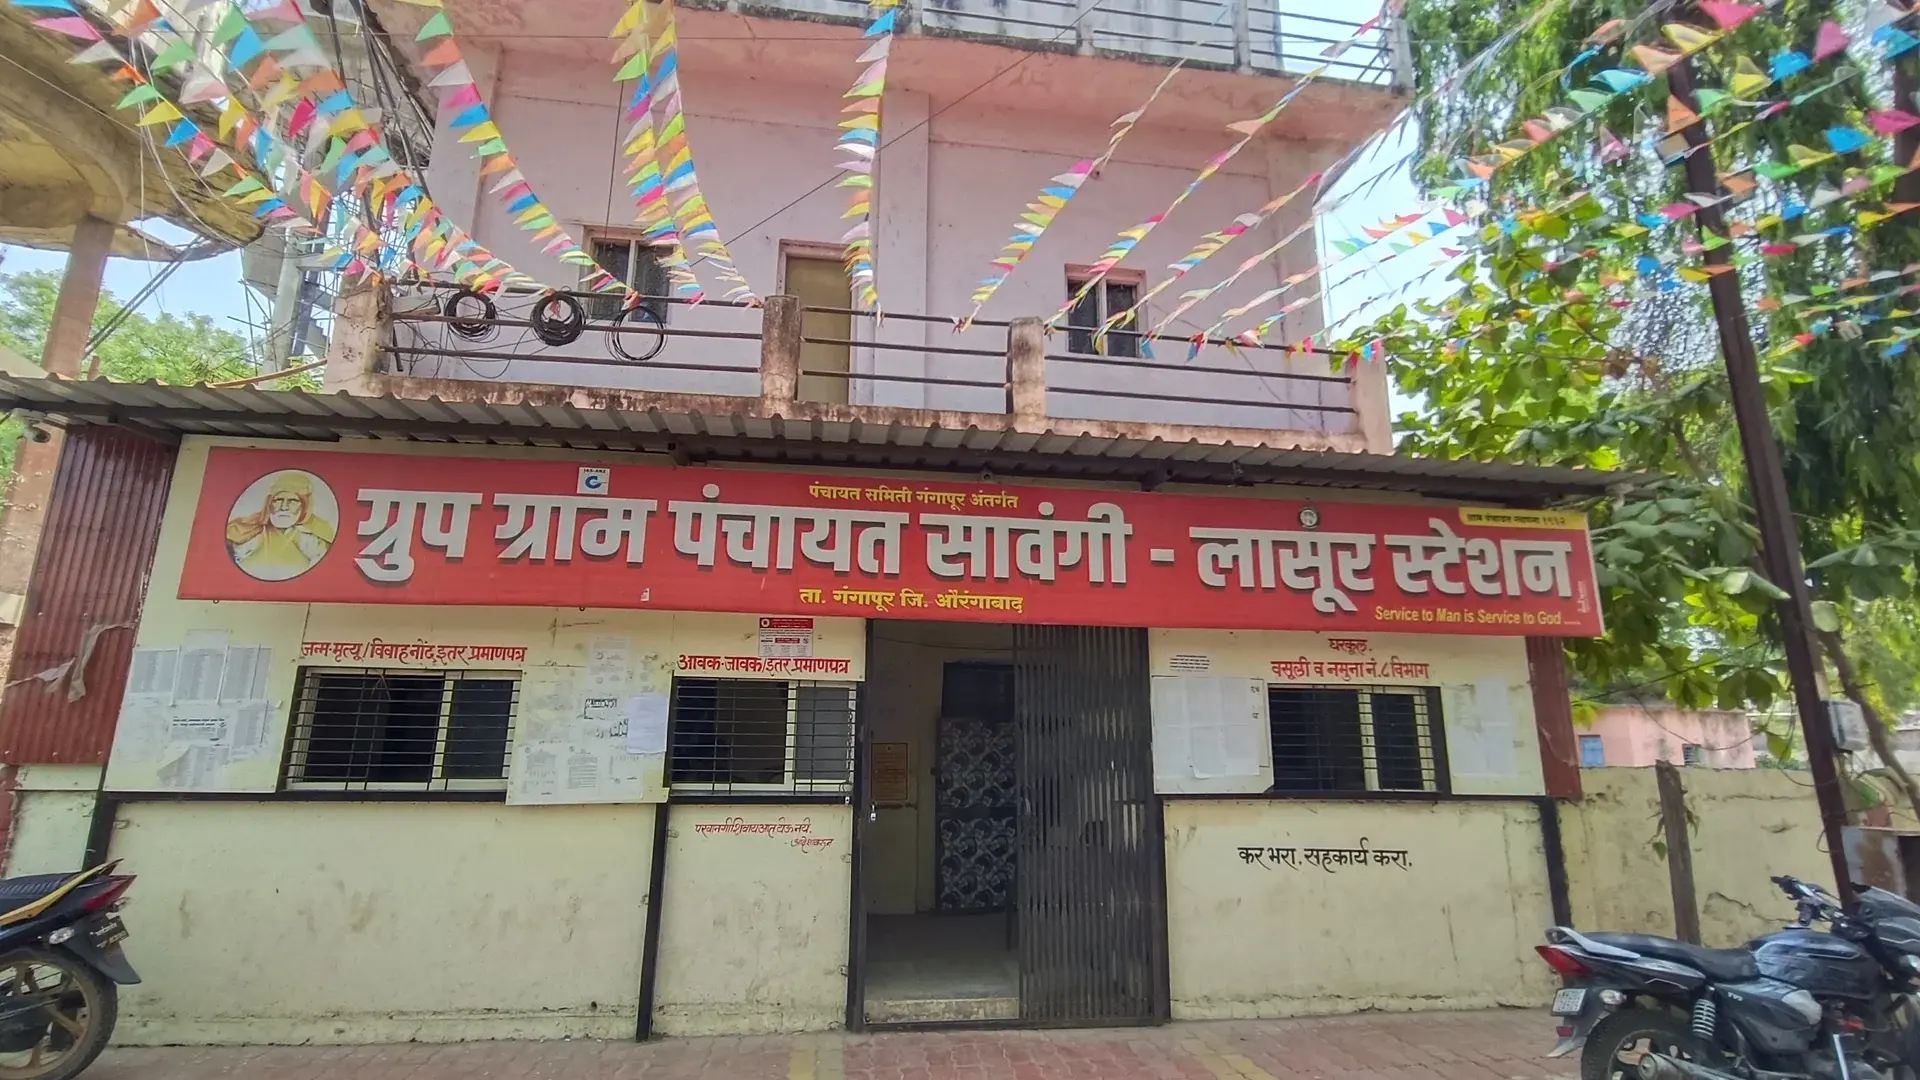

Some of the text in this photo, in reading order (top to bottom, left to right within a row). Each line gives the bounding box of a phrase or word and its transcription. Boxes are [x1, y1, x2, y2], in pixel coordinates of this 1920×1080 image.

[809, 481, 1018, 511] पंचायत समिती गंगापूर अंतर्गत
[354, 488, 483, 582] ग्रुप
[493, 492, 658, 564] ग्राम
[668, 484, 909, 576] पंचायत
[920, 502, 1133, 585] सावंगी
[1189, 526, 1376, 613] लासूर
[1383, 518, 1573, 598] स्टेशन
[799, 586, 1024, 614] ता. गंगापूर जि. औरंगाबाद
[1375, 606, 1562, 625] Service to Man is Service to God
[468, 645, 528, 662] प्रमाणपत्र
[1314, 662, 1325, 677] व
[1390, 656, 1429, 679] विभाग
[1237, 837, 1412, 873] कर भरा. सहकार्य करा.
